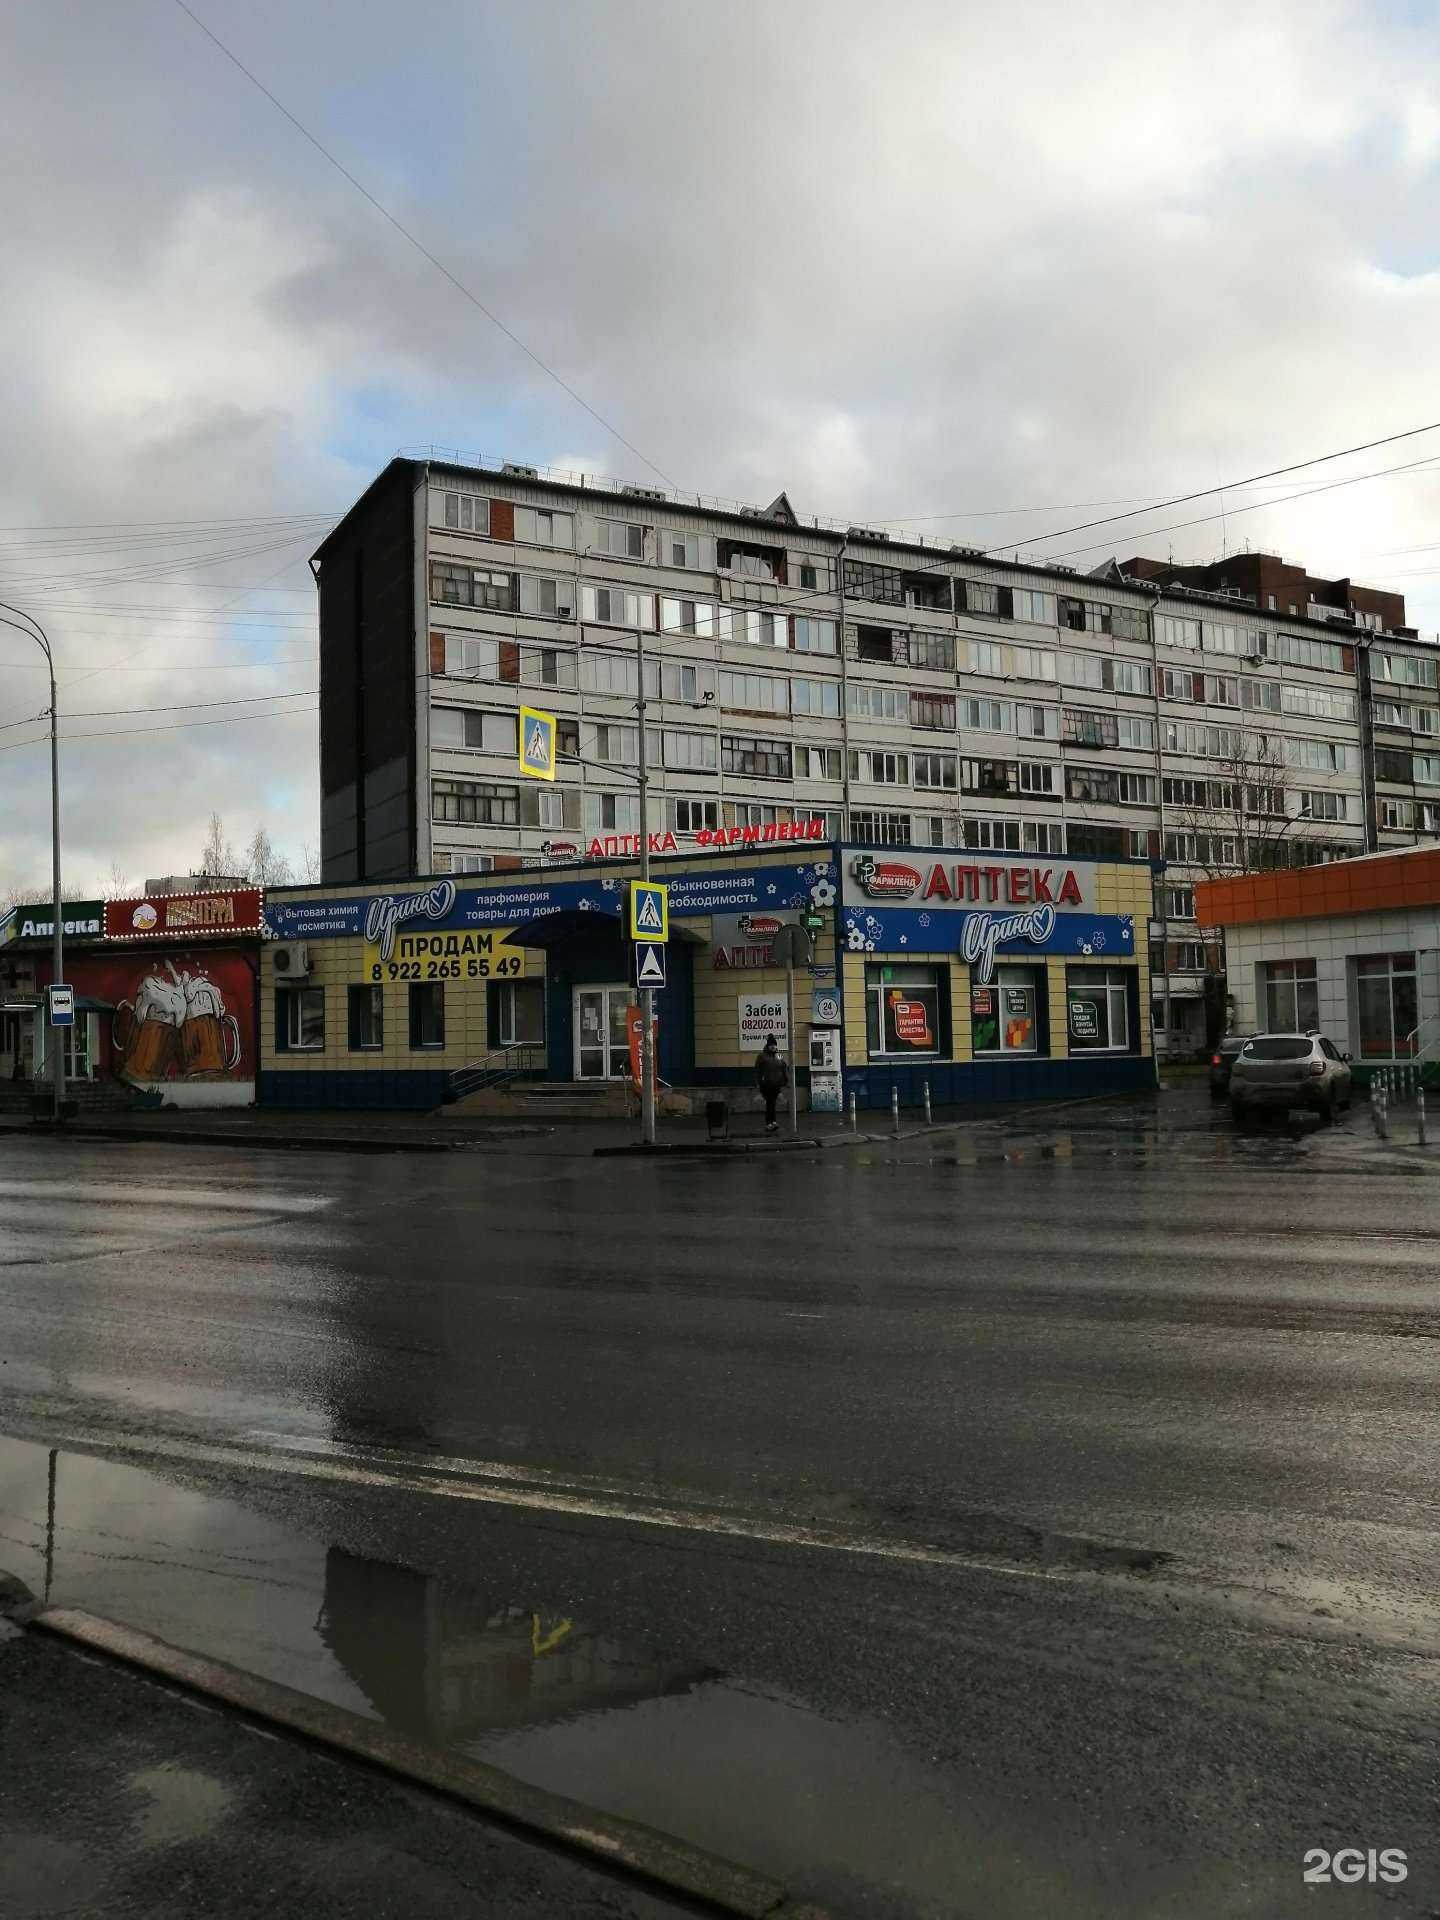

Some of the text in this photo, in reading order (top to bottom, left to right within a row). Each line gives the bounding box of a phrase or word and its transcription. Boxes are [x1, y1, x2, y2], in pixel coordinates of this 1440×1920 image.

[586, 818, 825, 857] АПТЕКА ФАРМЛЕНД
[922, 863, 1084, 904] АПТЕКА
[477, 892, 550, 906] парфюмерия
[667, 894, 758, 908] еобходимость
[285, 906, 359, 918] бытовая химия
[466, 905, 561, 921] товары для дома
[297, 921, 346, 932] косметика
[400, 934, 493, 958] ПРОДАМ
[372, 957, 521, 981] 8 922 265 55 49
[745, 1003, 782, 1017] Забей
[823, 1002, 833, 1011] 24
[741, 1019, 786, 1030] 082020.ru
